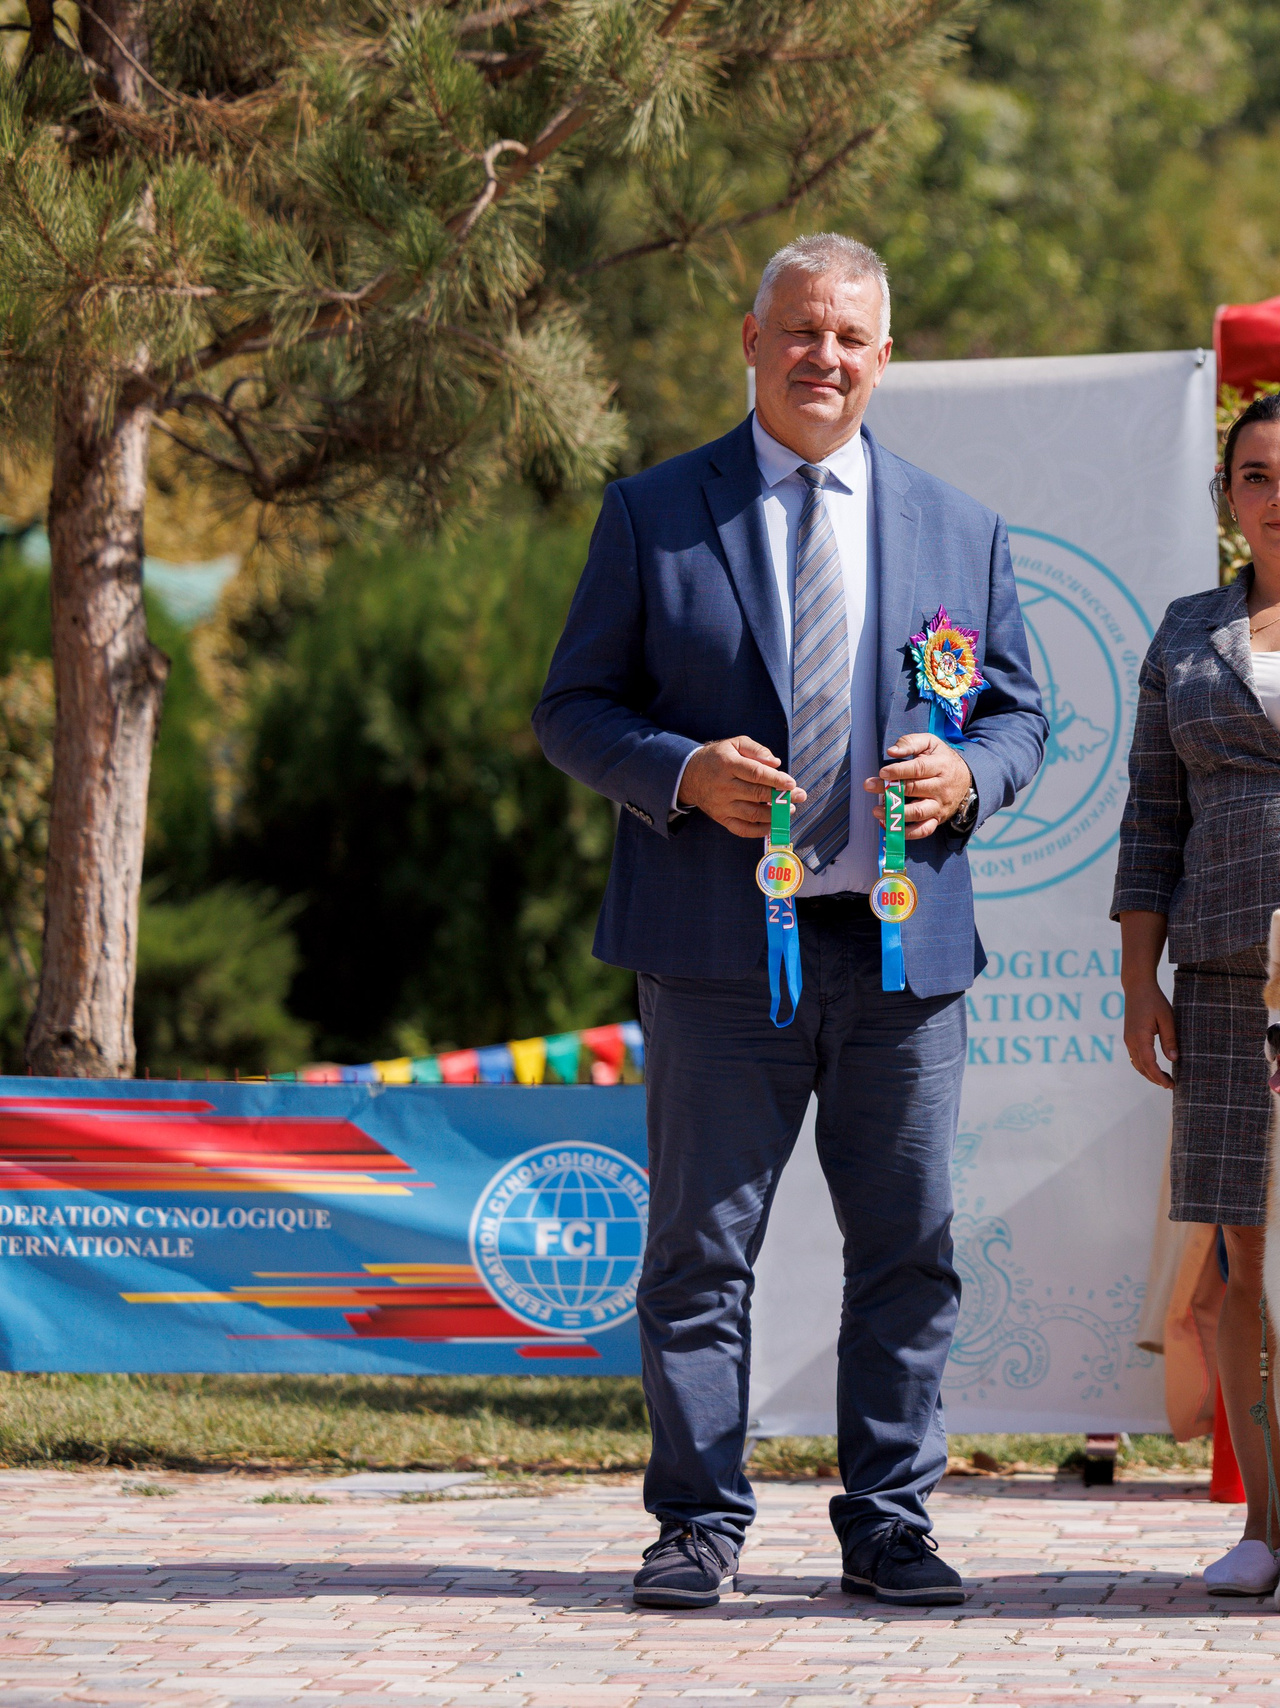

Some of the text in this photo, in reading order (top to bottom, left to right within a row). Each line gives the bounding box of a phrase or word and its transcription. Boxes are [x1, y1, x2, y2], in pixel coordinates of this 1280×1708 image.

[767, 865, 792, 882] BOB
[881, 891, 905, 906] BOS
[966, 1034, 1116, 1065] KISTAN
[488, 1151, 624, 1215] CYNOLOGIQUE
[0, 1205, 332, 1234] DERATION CYNOLOGIQUE
[534, 1220, 608, 1256] FCI
[479, 1216, 554, 1322] FEDERATION
